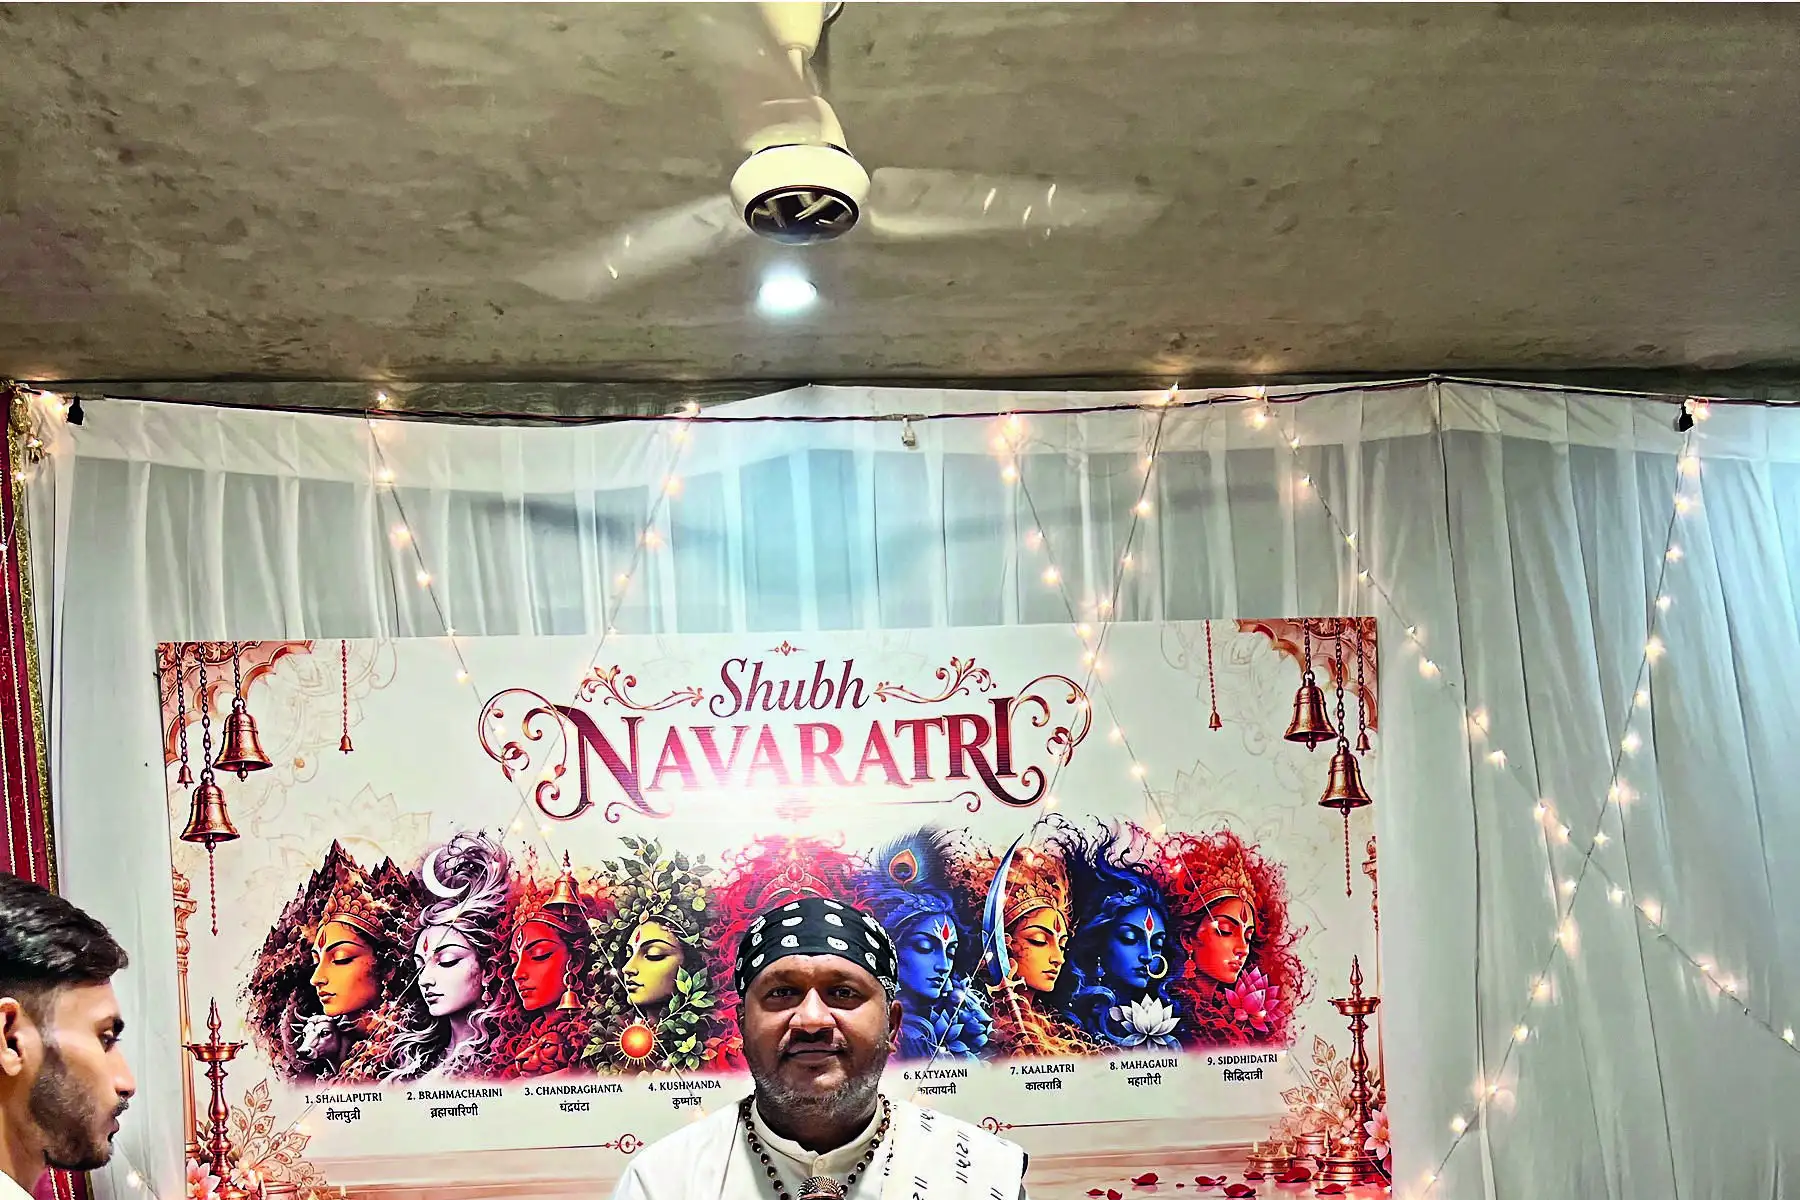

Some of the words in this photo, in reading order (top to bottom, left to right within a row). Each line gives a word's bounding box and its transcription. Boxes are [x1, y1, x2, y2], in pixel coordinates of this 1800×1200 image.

[709, 658, 869, 718] Shubh
[532, 696, 1047, 820] NAVARATRI
[1121, 1059, 1178, 1070] MAHAGAURI
[1218, 1054, 1278, 1065] SIDDHIDATRI
[915, 1069, 968, 1080] KATYAYANI
[1022, 1064, 1075, 1075] KAALRATRI
[536, 1084, 623, 1096] CHANDRAGHANTA
[660, 1080, 722, 1092] KUSHMANDA
[316, 1093, 383, 1105] SHAILAPUTRI
[419, 1088, 503, 1101] BRAHMACHARINI
